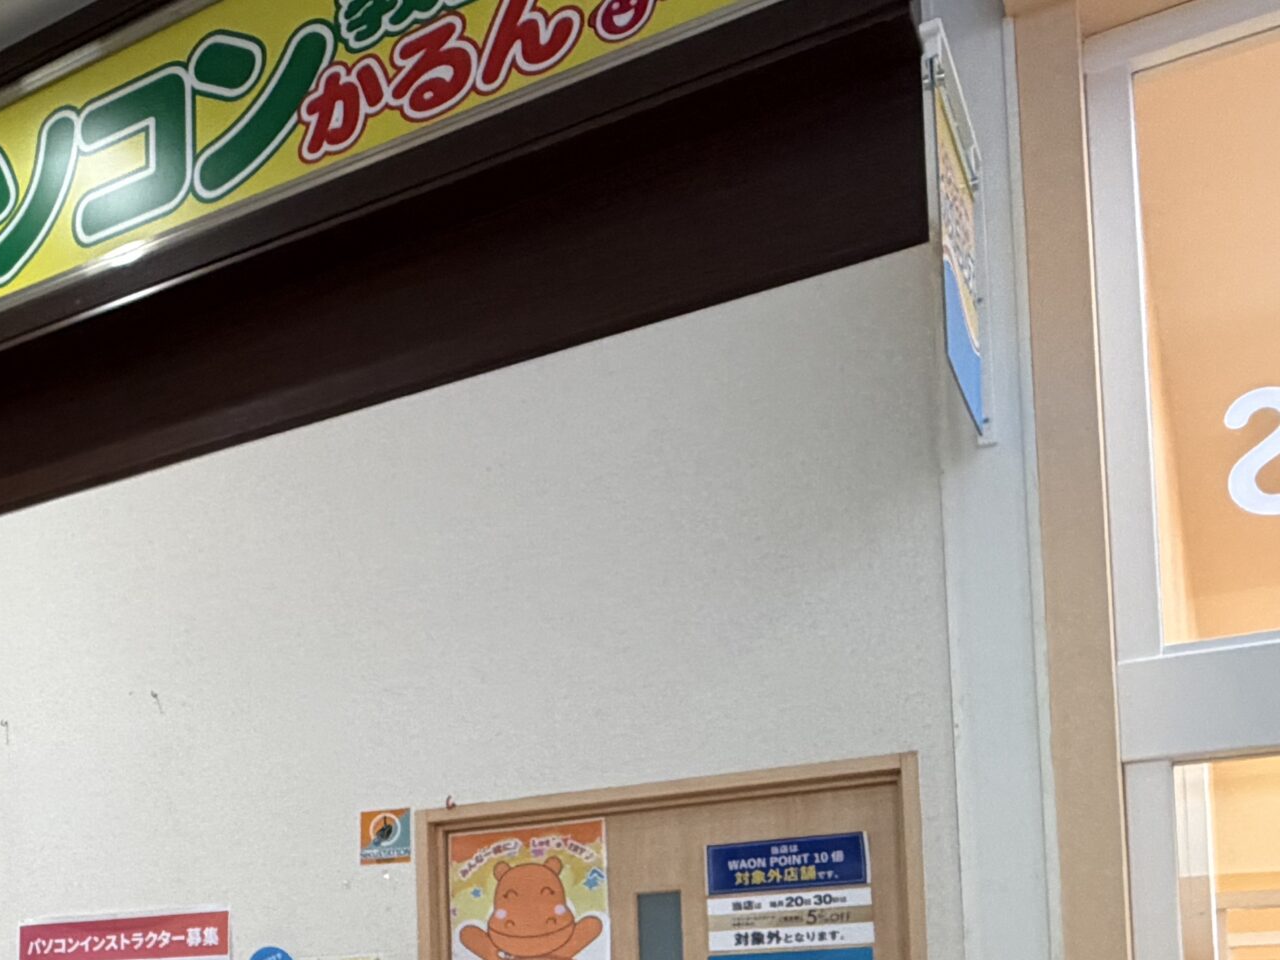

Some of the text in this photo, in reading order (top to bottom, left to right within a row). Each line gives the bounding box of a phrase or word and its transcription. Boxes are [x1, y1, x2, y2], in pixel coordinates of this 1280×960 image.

[298, 0, 585, 163] かるん
[727, 857, 767, 871] WAON
[770, 853, 810, 867] POINT
[814, 852, 828, 864] 10
[734, 865, 839, 886] 対象外店舗です。
[27, 927, 219, 956] パソコンインストラクター募集
[734, 930, 845, 946] 対象外となります。
